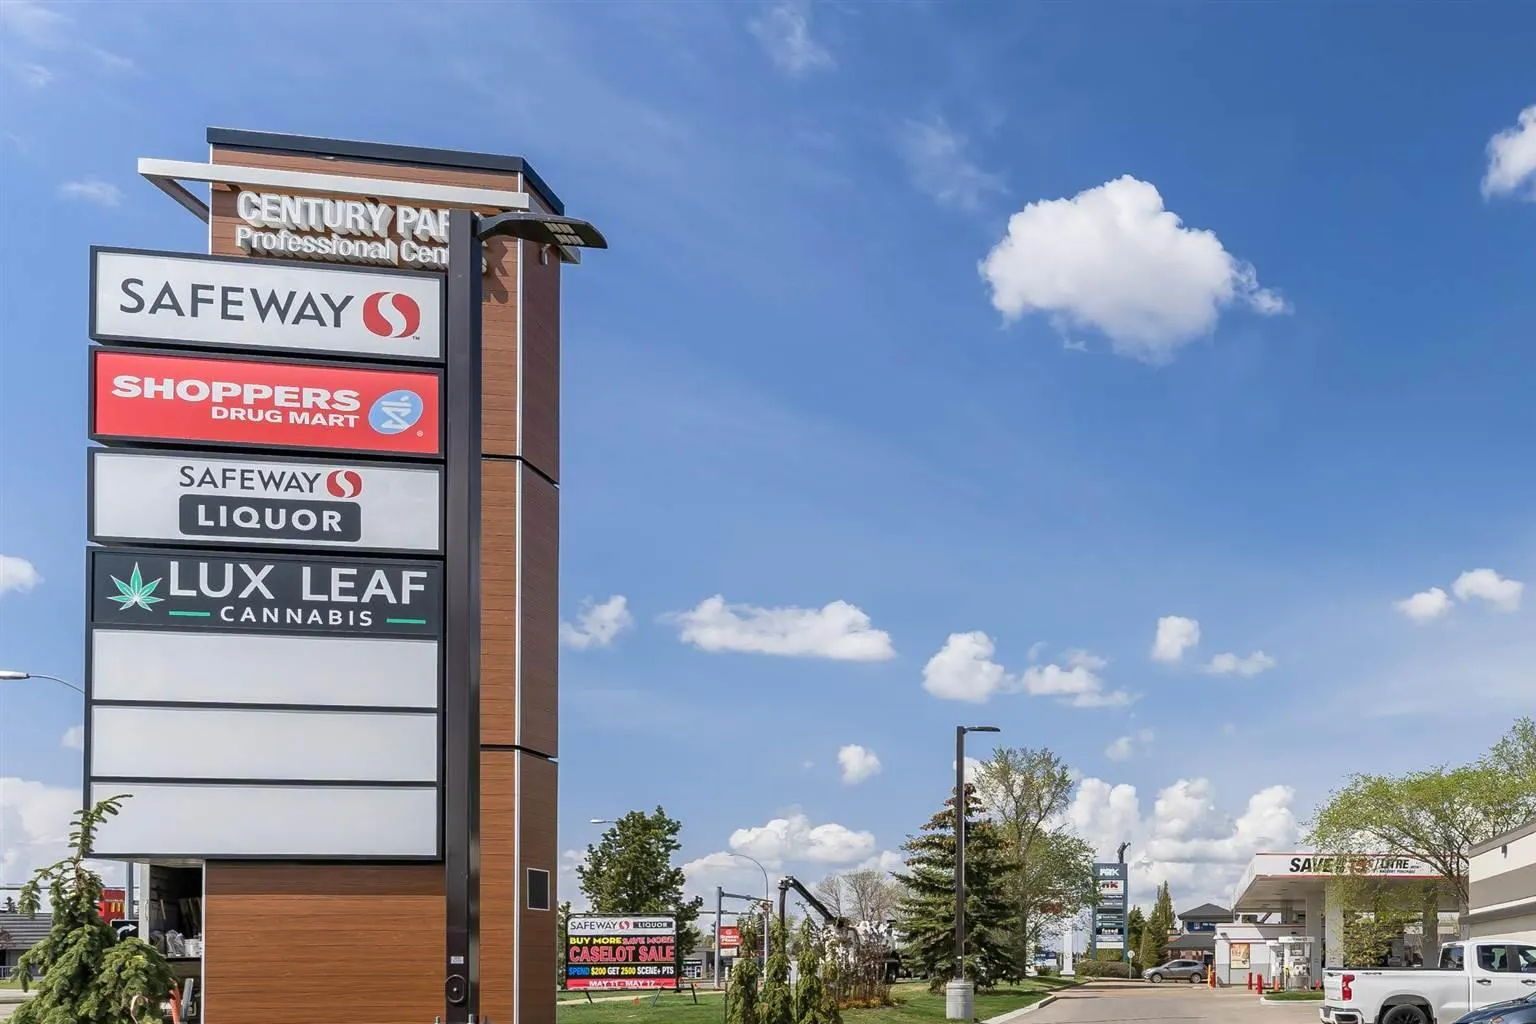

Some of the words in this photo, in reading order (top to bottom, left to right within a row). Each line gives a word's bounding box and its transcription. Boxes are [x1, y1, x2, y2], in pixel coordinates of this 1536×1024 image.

[237, 191, 394, 238] CENTURY
[236, 225, 398, 265] Professional
[119, 278, 354, 328] SAFEWAY
[112, 375, 361, 411] SHOPPERS
[211, 406, 283, 423] DRUG
[289, 412, 360, 427] MART
[179, 465, 321, 493] SAFEWAY
[198, 504, 342, 532] LIQUOR
[169, 561, 275, 599] LUX
[302, 566, 428, 604] LEAF
[221, 606, 372, 626] CANNABIS
[1289, 857, 1335, 873] SAVE
[570, 921, 617, 930] SAFEWAY
[569, 945, 636, 962] CASELOT
[638, 945, 675, 962] SALE
[568, 966, 590, 976] SPEND
[590, 966, 607, 975] $200
[607, 966, 620, 975] GET
[662, 966, 674, 974] PTS
